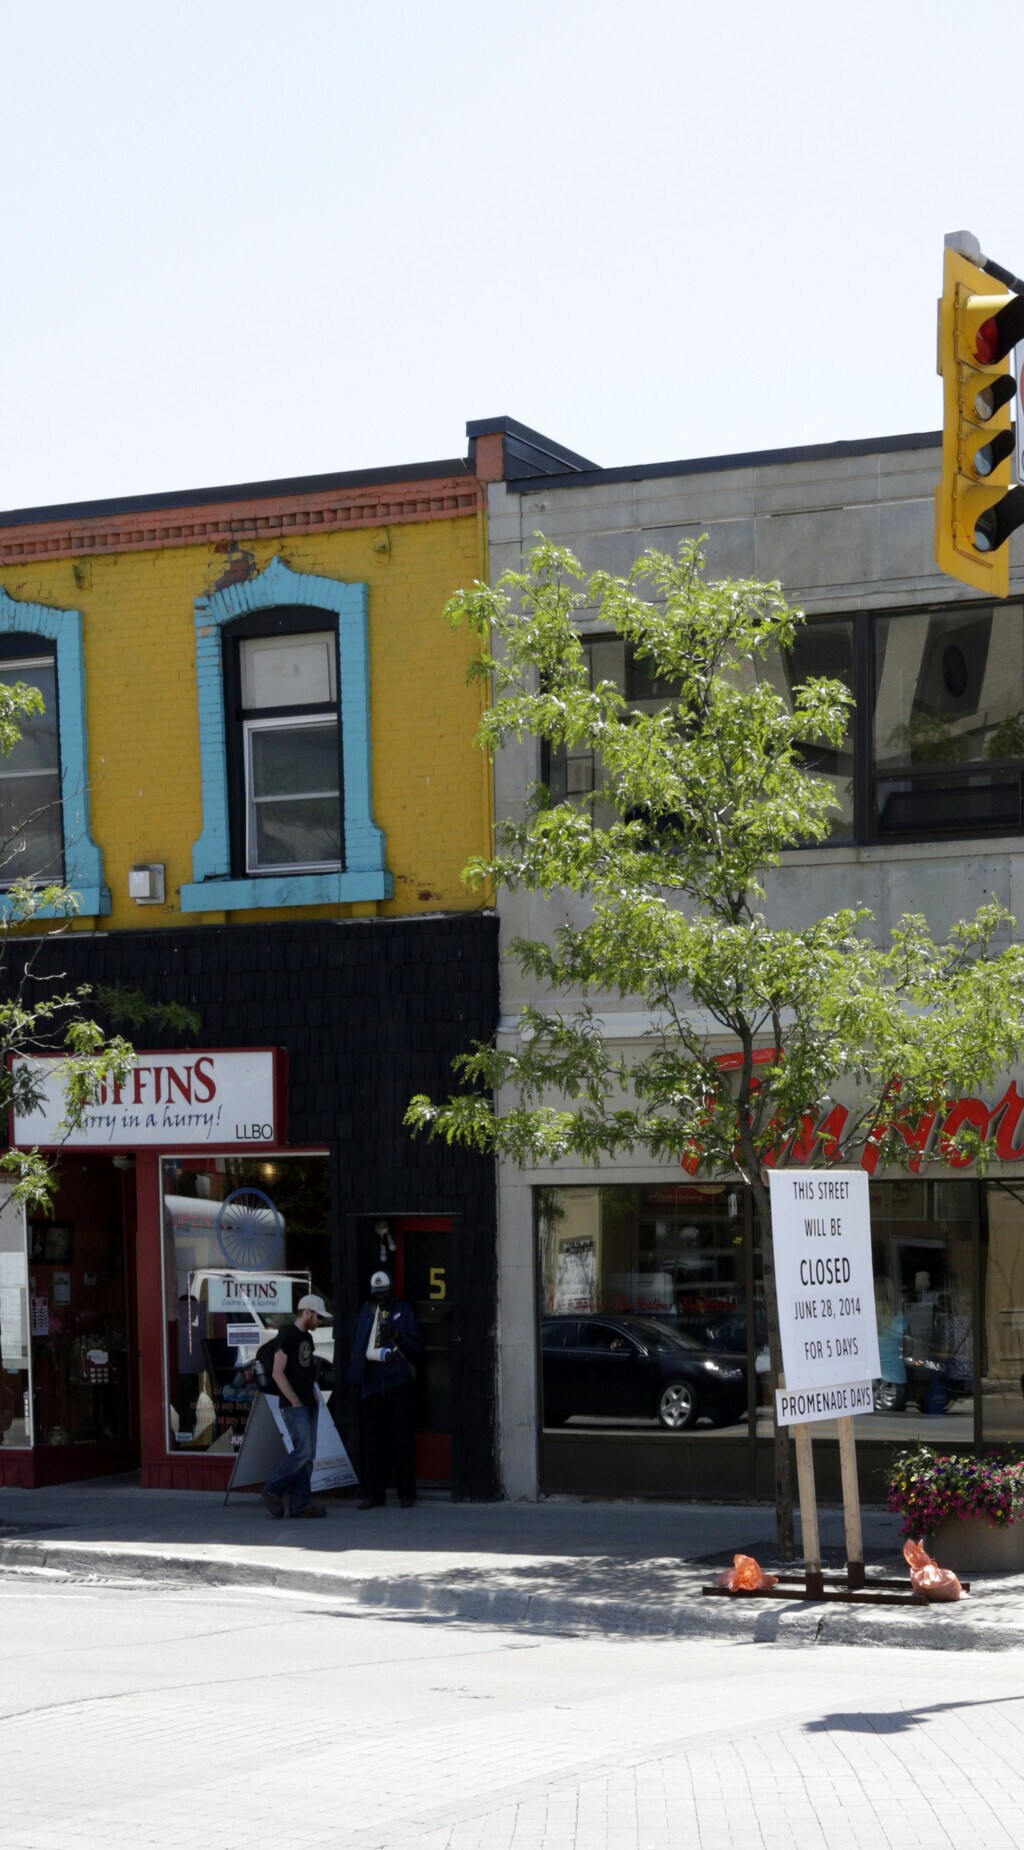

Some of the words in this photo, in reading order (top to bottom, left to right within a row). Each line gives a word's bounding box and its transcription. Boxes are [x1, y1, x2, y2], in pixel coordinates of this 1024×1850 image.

[80, 1057, 217, 1107] IFFINS
[121, 1108, 141, 1128] in
[145, 1113, 158, 1128] a
[162, 1105, 223, 1140] hurry!
[235, 1124, 274, 1140] LLBO
[793, 1181, 815, 1200] THIS
[818, 1181, 850, 1200] STREET
[804, 1218, 827, 1237] WILL
[830, 1218, 842, 1236] BE
[430, 1267, 446, 1299] 5
[800, 1257, 851, 1286] CLOSED
[223, 1280, 278, 1298] TIFFINS
[795, 1300, 818, 1320] JUNE
[820, 1299, 836, 1320] 28,
[839, 1297, 861, 1316] 2014
[804, 1341, 823, 1360] FOR
[826, 1340, 833, 1358] 5
[836, 1337, 859, 1357] DAYS
[781, 1389, 848, 1417] PROMENADE
[850, 1386, 871, 1408] DAYS
